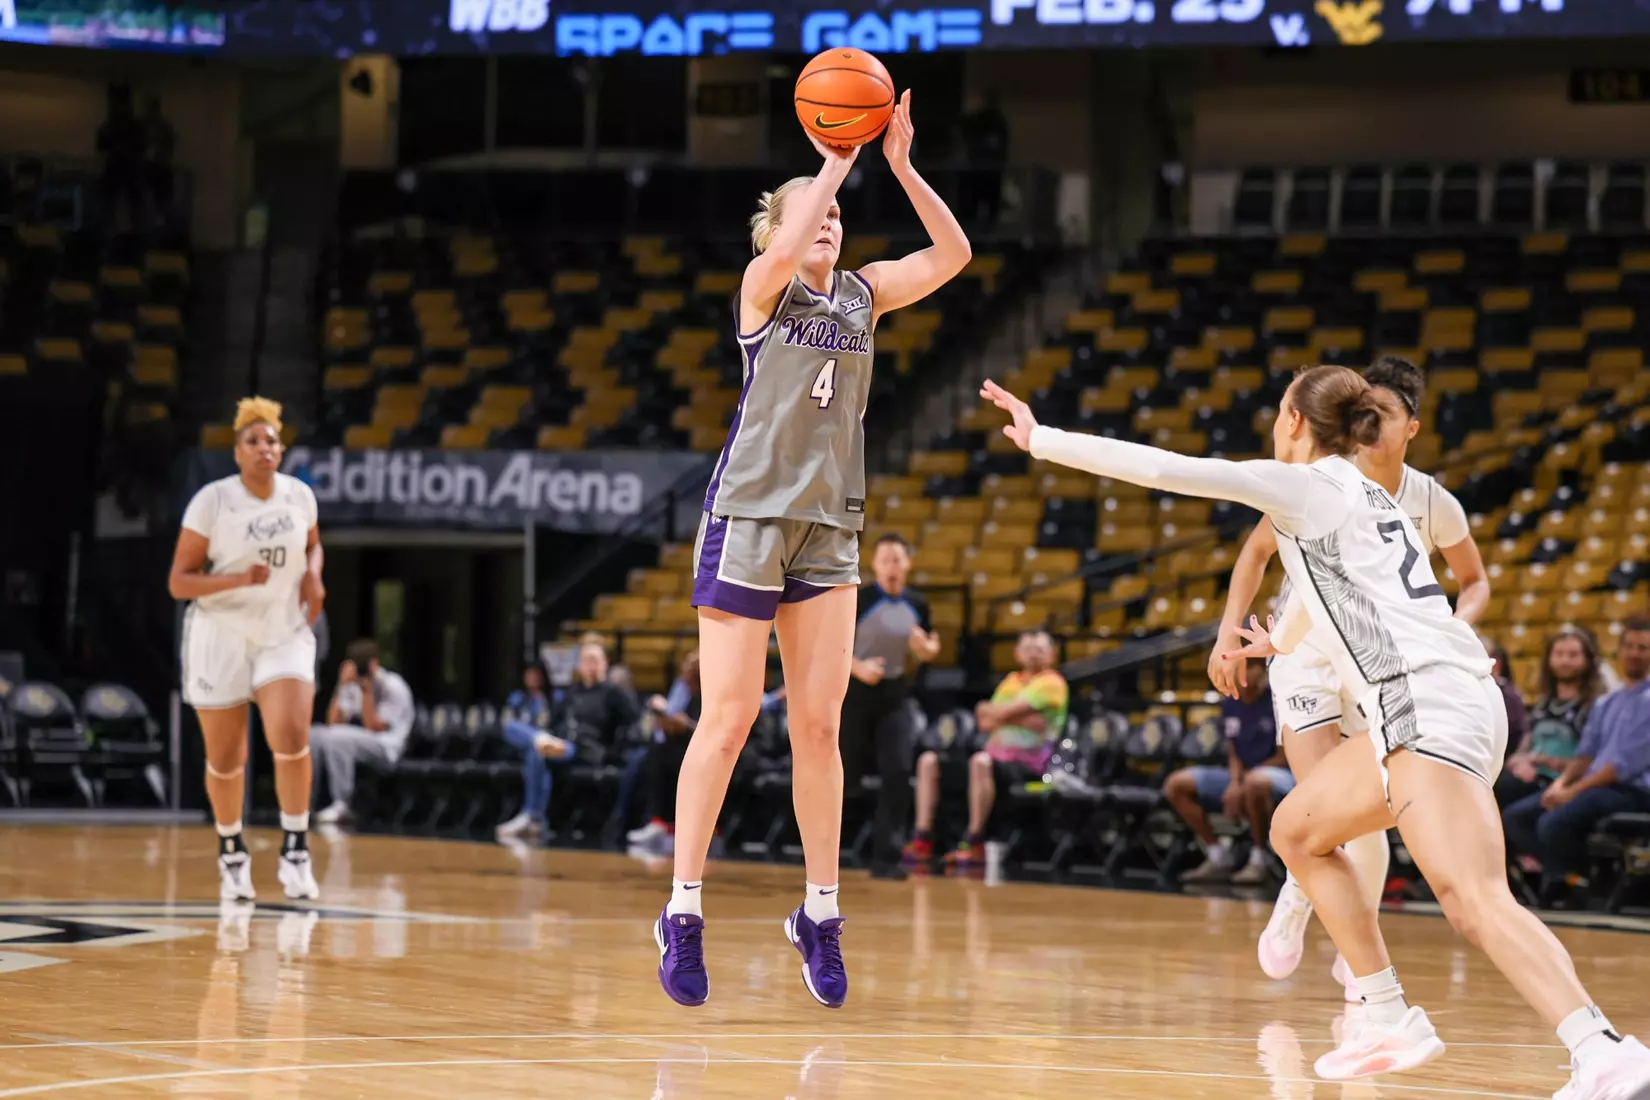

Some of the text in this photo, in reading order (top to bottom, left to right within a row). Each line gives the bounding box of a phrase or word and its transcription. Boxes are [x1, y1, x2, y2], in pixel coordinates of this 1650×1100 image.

[802, 9, 982, 53] GAME
[781, 316, 869, 354] Wildcats
[810, 358, 837, 409] 4
[490, 453, 643, 514] Arena
[1376, 520, 1445, 599] 2
